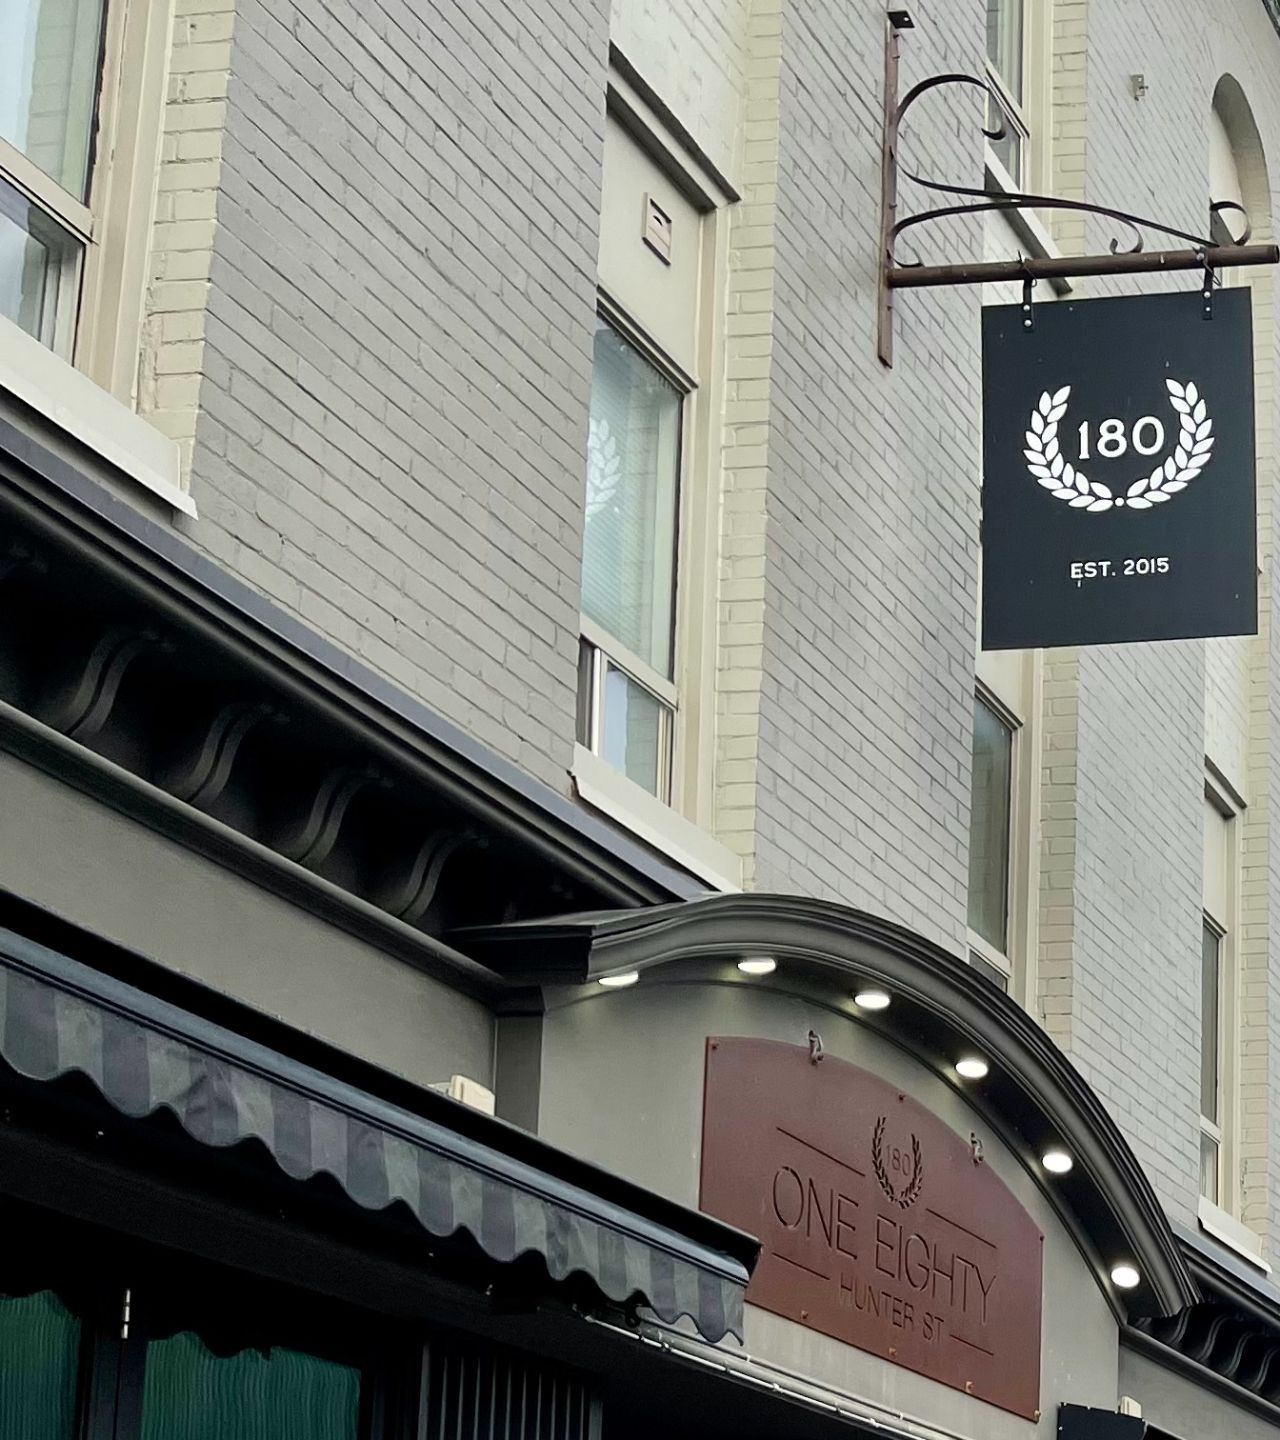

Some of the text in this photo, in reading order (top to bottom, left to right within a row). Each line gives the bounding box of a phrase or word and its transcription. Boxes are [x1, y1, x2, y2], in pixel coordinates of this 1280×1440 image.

[1078, 416, 1165, 460] 180
[1070, 557, 1169, 579] EST. 2015
[886, 1144, 912, 1177] 180
[773, 1165, 997, 1326] ONE EIGHTY
[840, 1271, 945, 1343] HUNTER ST
